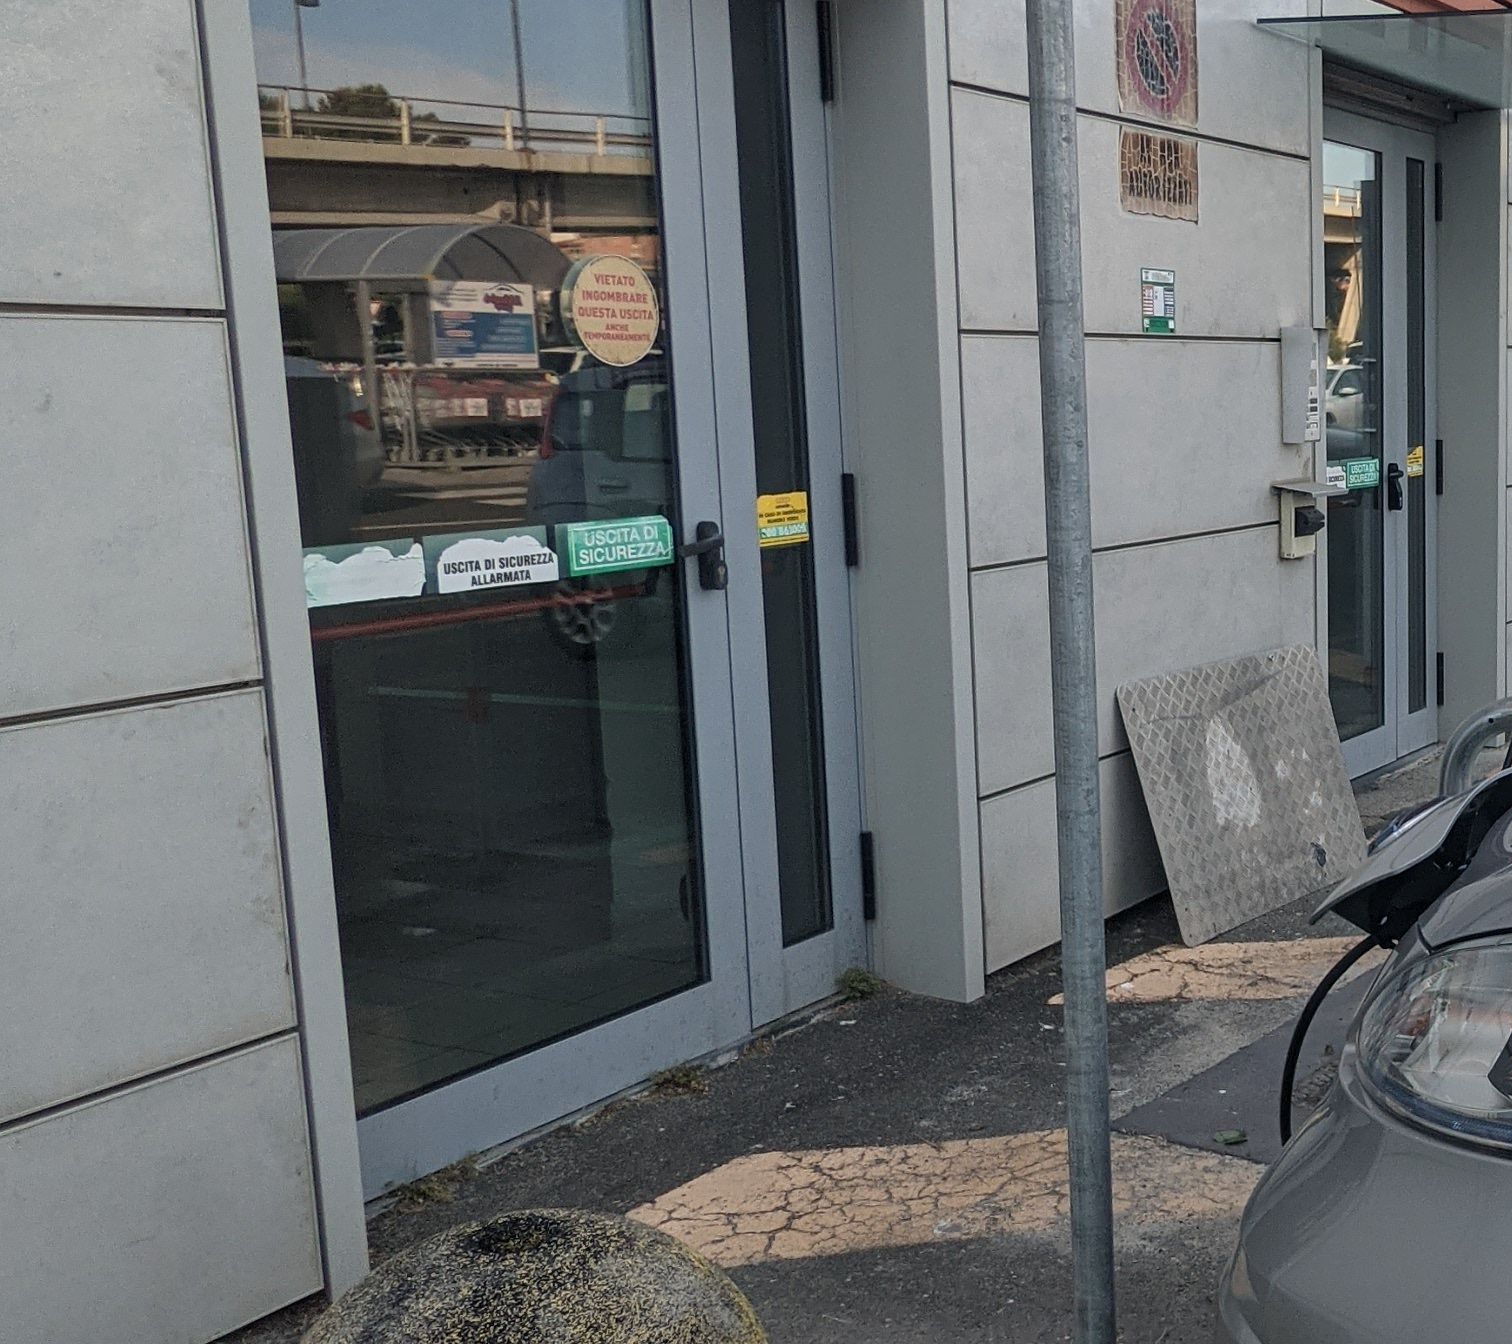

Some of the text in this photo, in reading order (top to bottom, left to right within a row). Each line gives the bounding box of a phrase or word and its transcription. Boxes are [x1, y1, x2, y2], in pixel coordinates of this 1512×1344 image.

[594, 274, 635, 287] VIETATO
[582, 290, 648, 304] INGOMBRARE
[578, 306, 654, 320] QUESTA USCITA
[605, 323, 629, 332] ANCHE
[1351, 464, 1369, 473] USCITA
[583, 525, 658, 547] USCITA DI
[579, 541, 665, 565] SICUREZZA
[443, 552, 554, 575] USCITA DI SICUREZZA
[471, 570, 532, 587] ALLARMATA
